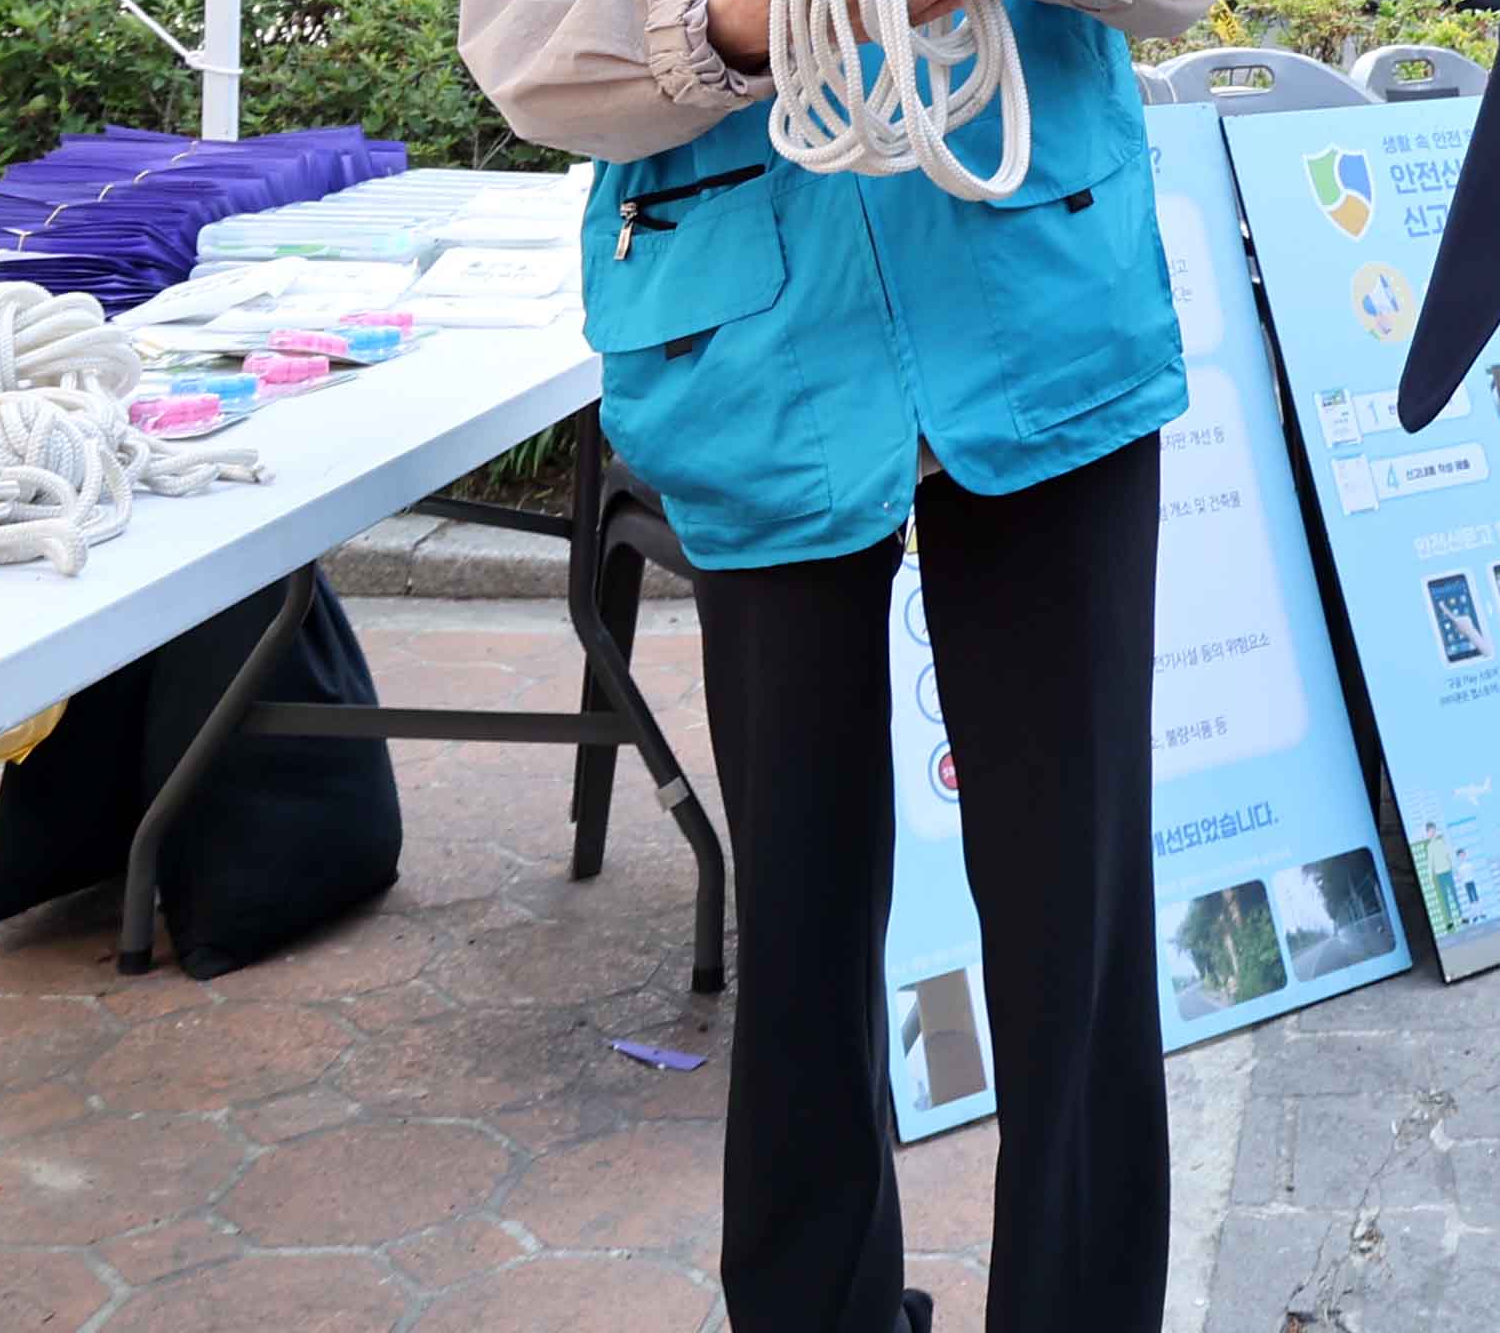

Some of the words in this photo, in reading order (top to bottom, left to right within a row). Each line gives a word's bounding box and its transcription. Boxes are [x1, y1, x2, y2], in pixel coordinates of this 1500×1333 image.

[1382, 134, 1412, 155] 생활
[1415, 132, 1429, 151] 속
[1432, 130, 1462, 151] 안전
[1386, 461, 1399, 489] 4
